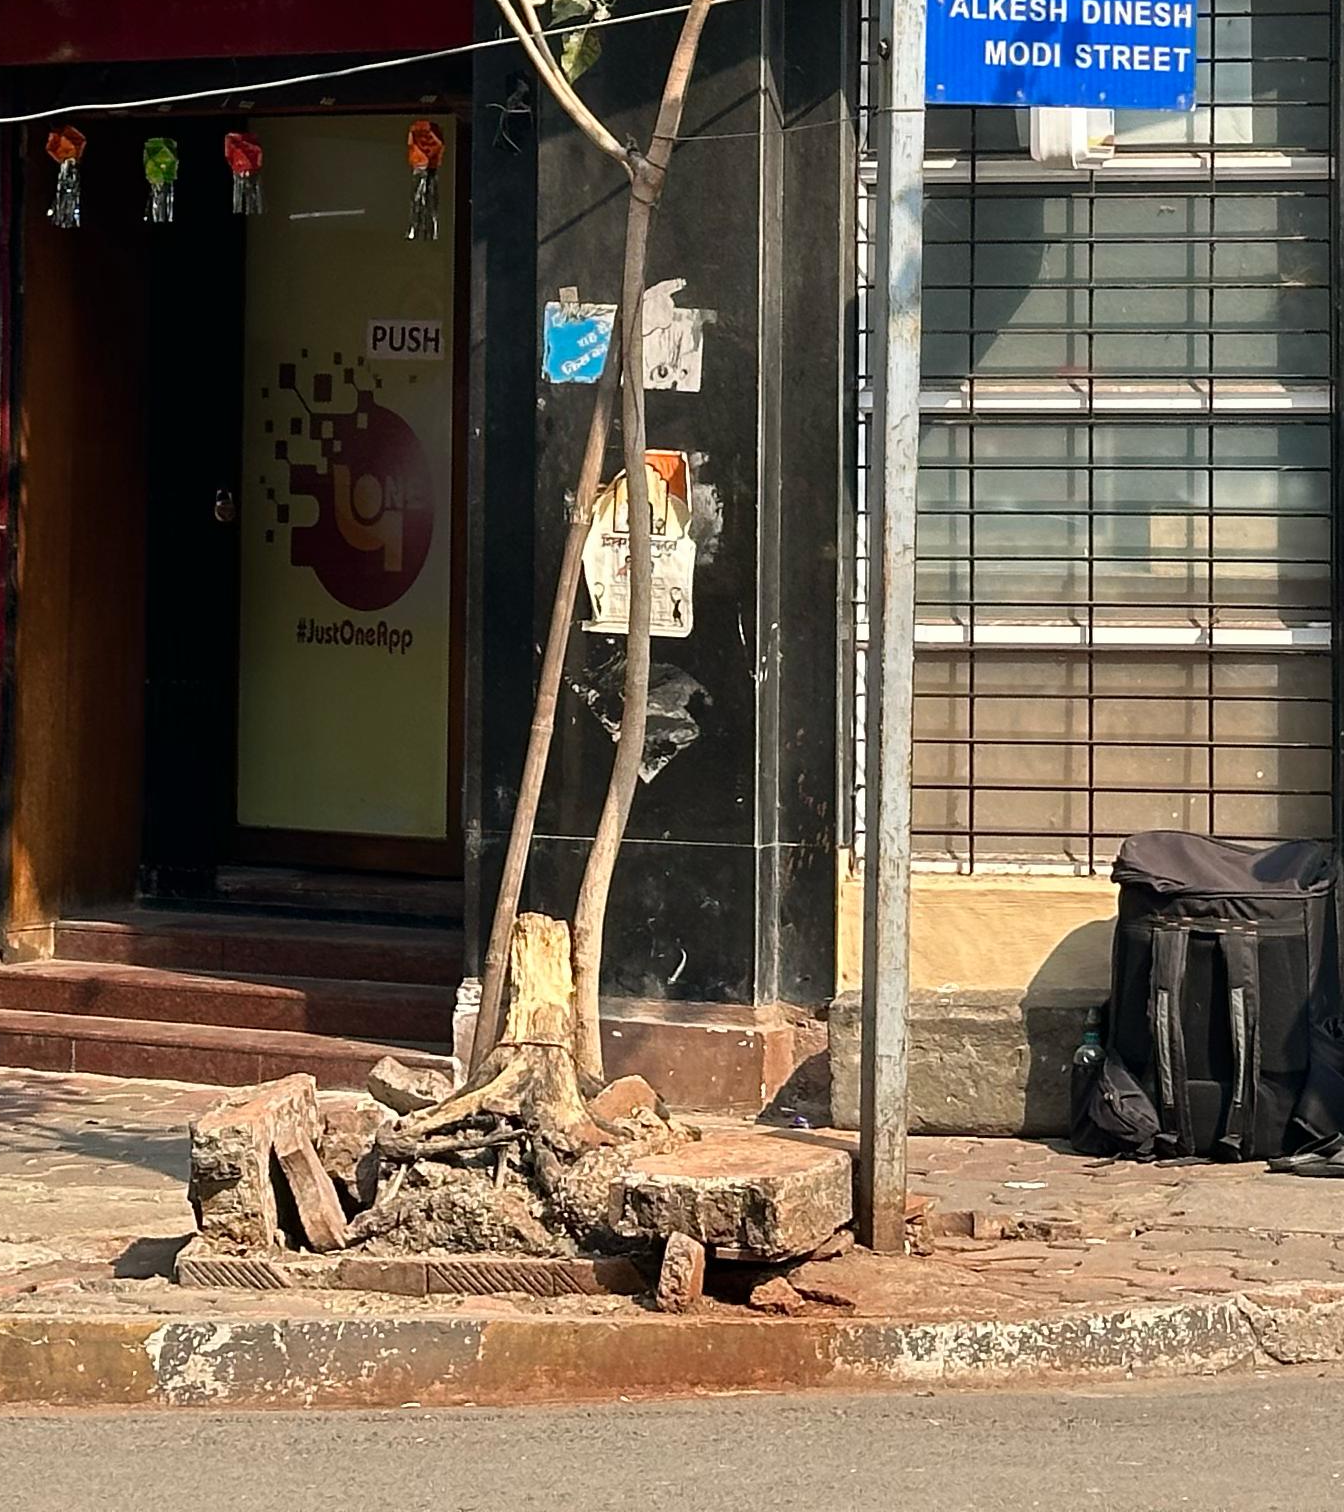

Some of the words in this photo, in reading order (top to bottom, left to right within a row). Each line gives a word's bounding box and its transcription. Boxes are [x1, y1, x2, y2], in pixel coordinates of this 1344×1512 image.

[1082, 0, 1193, 27] DINESH
[984, 39, 1061, 68] MODI
[1075, 44, 1191, 73] STREET
[371, 325, 441, 353] PUSH
[297, 617, 414, 655] #JustOneApp
